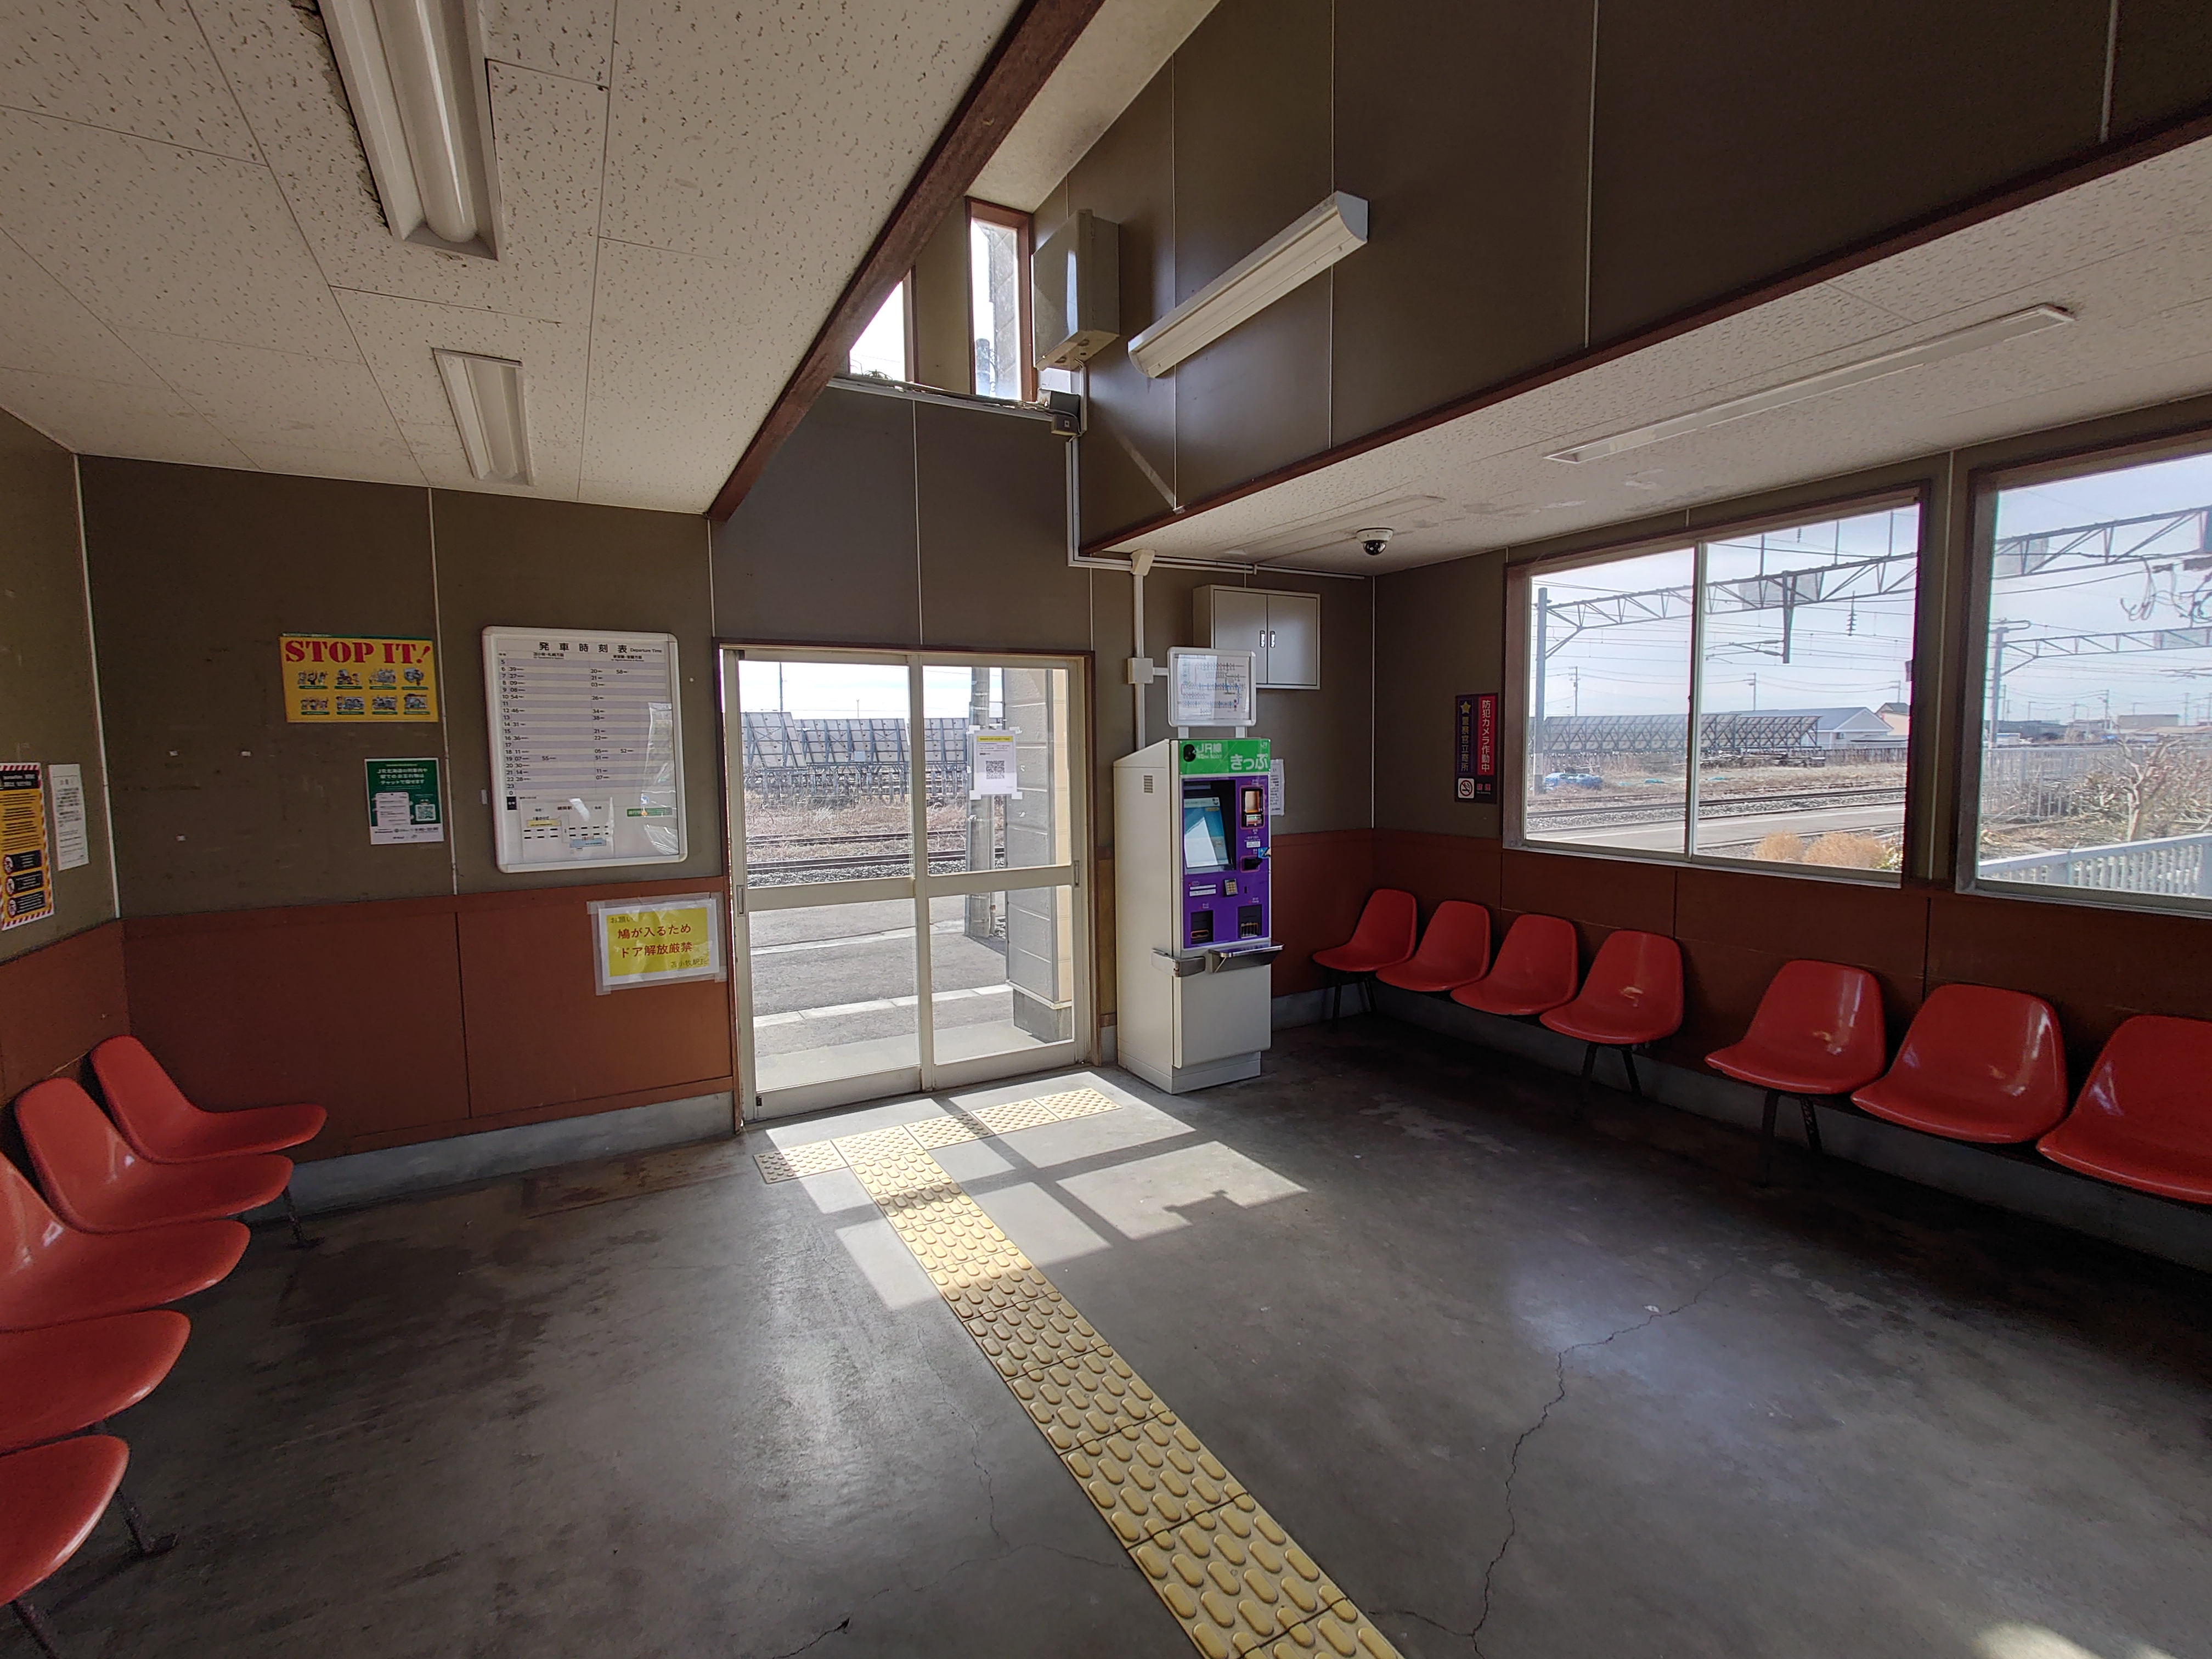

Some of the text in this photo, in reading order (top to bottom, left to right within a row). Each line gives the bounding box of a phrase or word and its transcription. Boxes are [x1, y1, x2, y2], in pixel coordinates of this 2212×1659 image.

[285, 641, 430, 664] STOP IT!
[539, 642, 628, 653] 発車時刻表
[1482, 700, 1491, 772] 防犯カメラ作動中
[1231, 754, 1268, 770] きっぷ
[618, 924, 691, 939] 鳩が入るため
[622, 941, 692, 958] ドア解放厳禁
